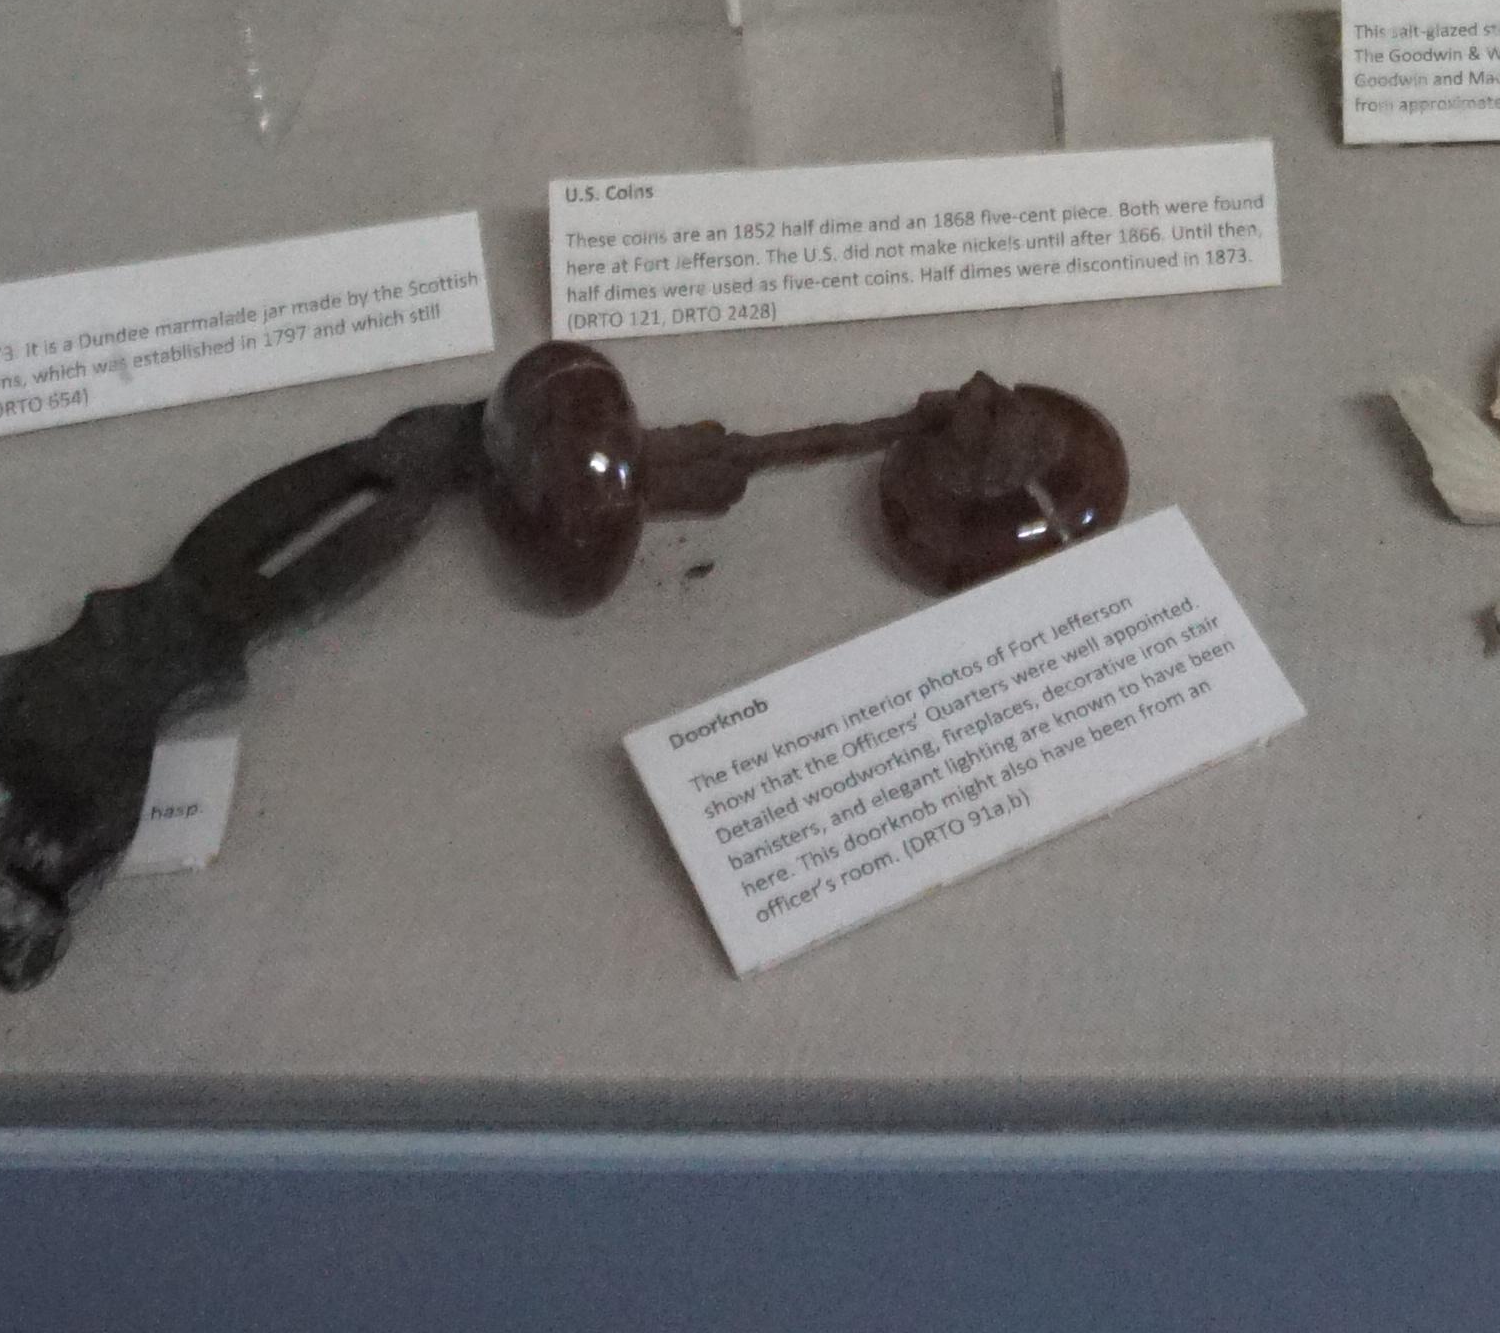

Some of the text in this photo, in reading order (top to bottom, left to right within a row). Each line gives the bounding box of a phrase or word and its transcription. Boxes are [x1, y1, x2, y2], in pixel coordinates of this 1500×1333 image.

[563, 182, 655, 205] U.S. Coins
[565, 299, 778, 329] (DRTO 121, DRTO 2428)
[46, 387, 91, 411] 654)
[666, 694, 771, 750] Doorknob
[713, 615, 1221, 845] Detailed woodworking, fireplaces, decorative iron stair
[838, 852, 900, 885] room.
[899, 816, 968, 861] (DRTO
[965, 787, 1033, 829] 91a,b)
